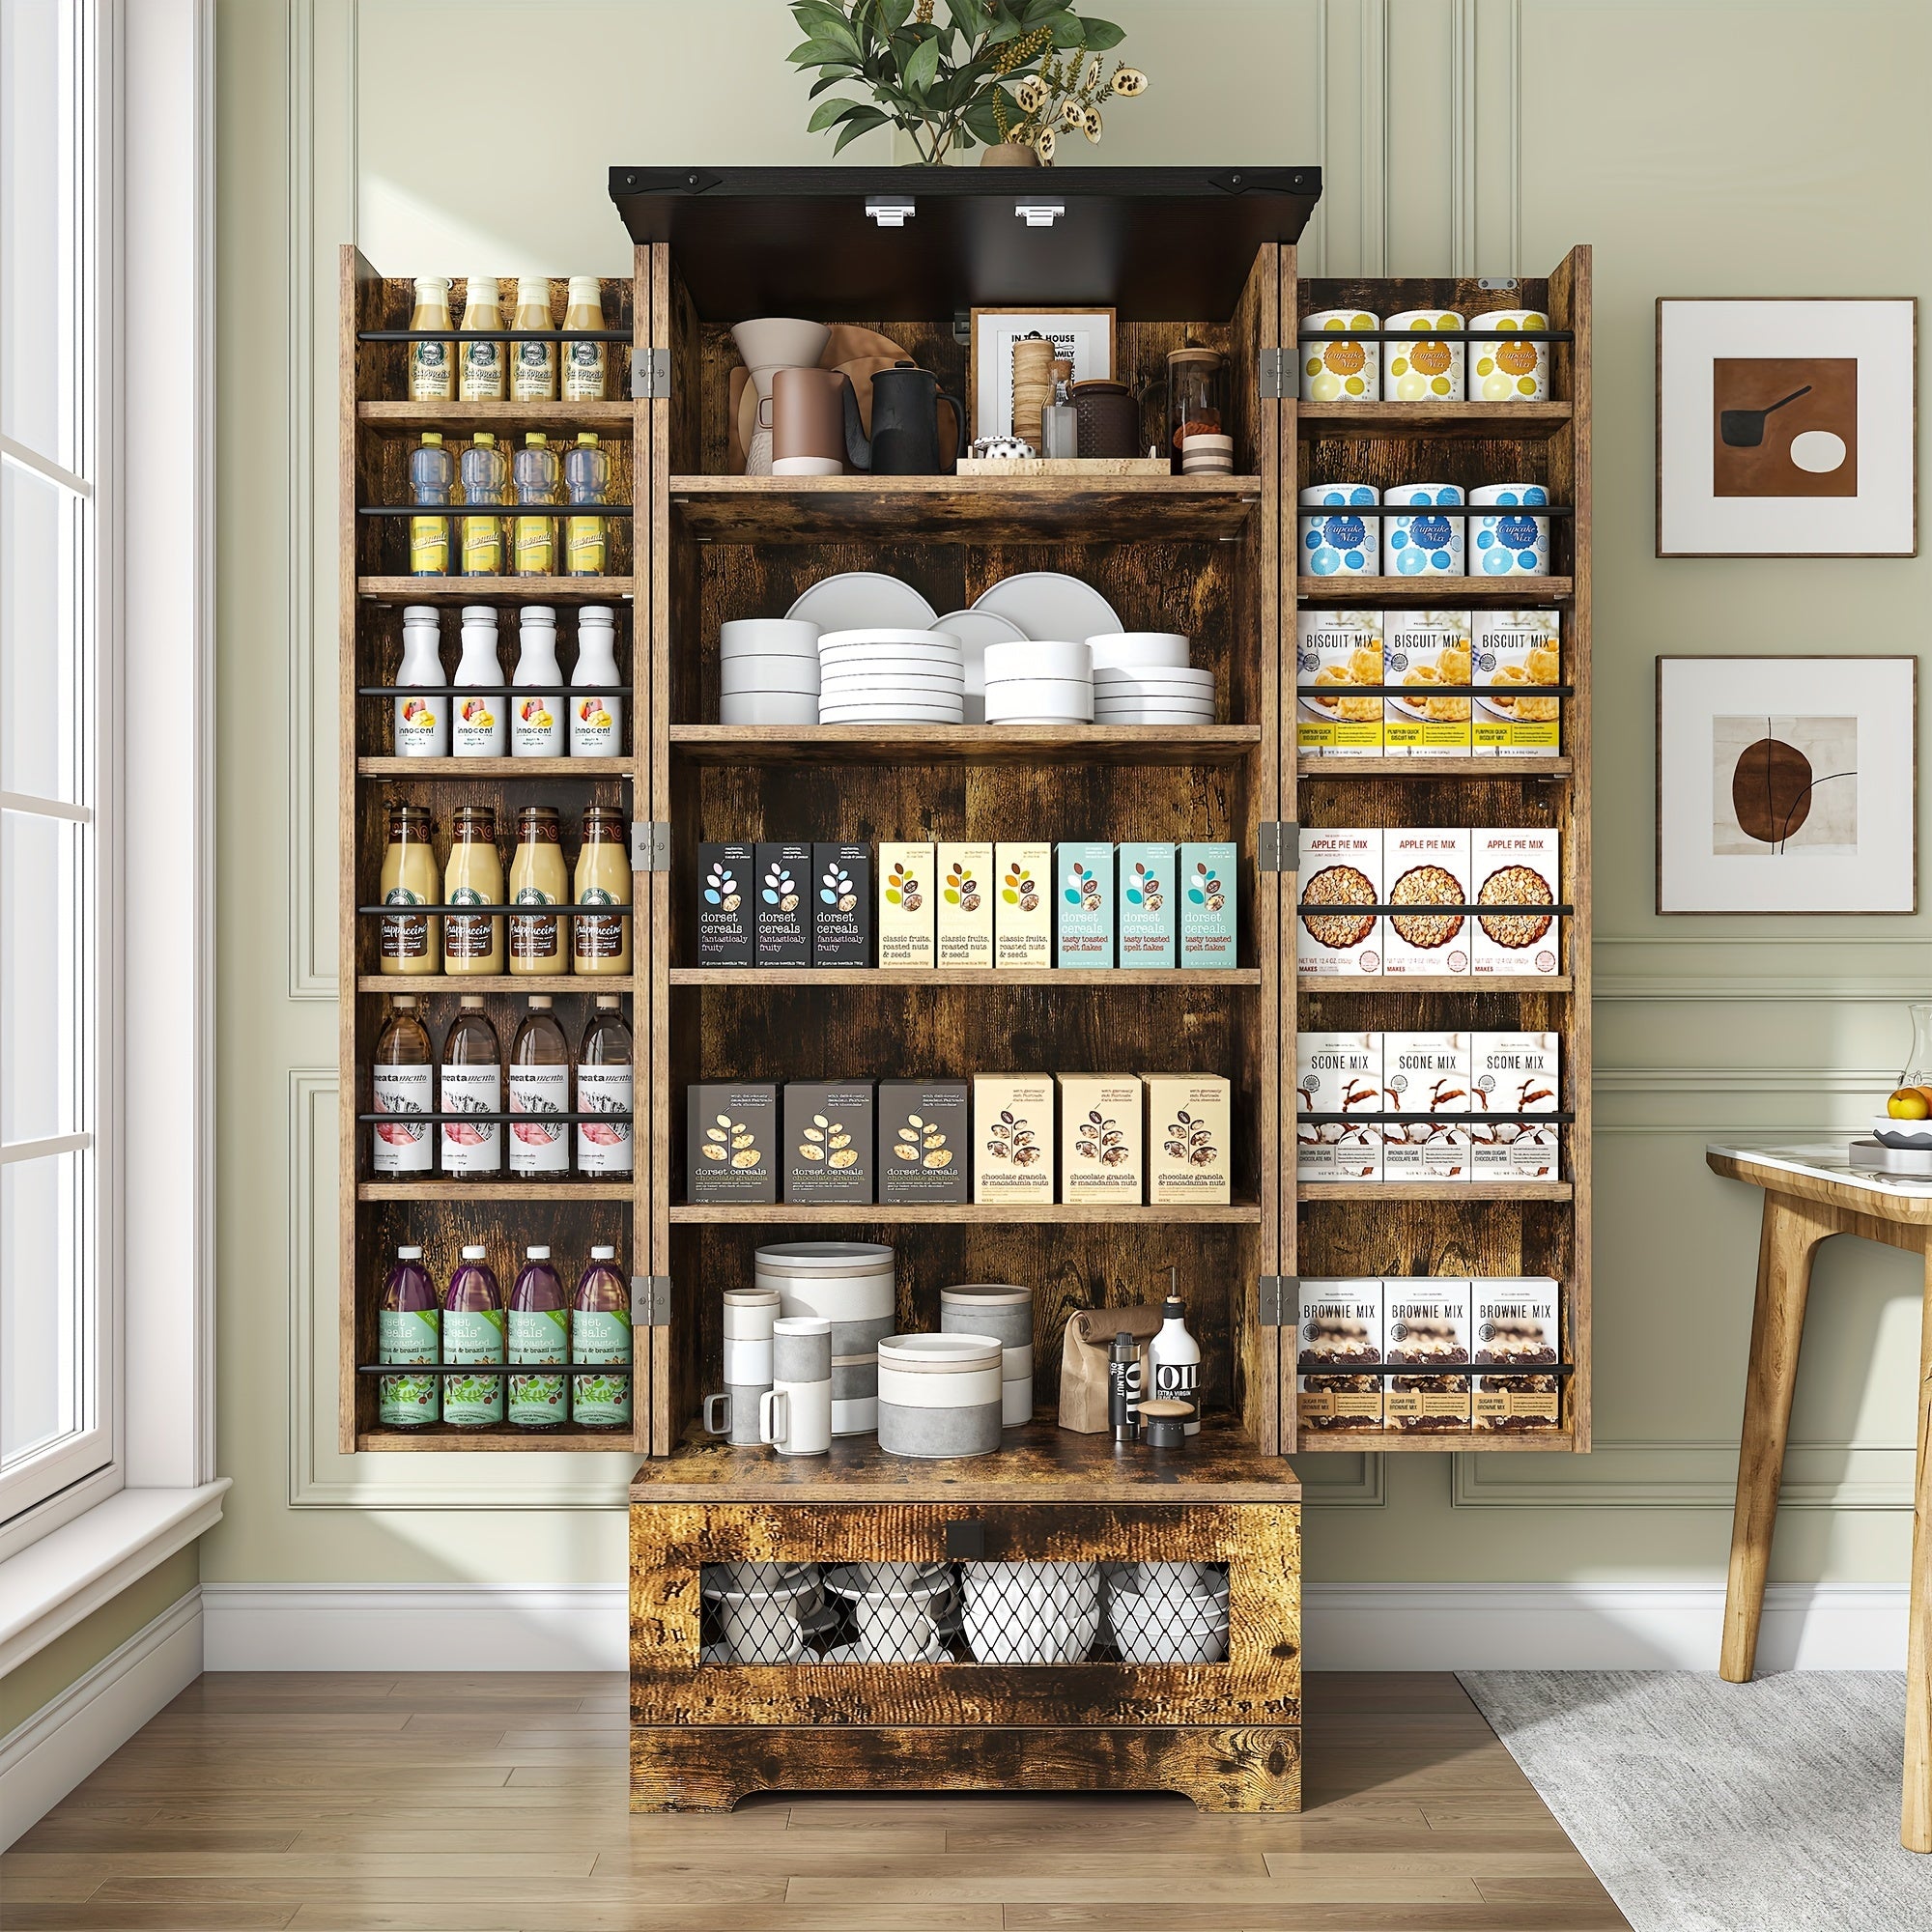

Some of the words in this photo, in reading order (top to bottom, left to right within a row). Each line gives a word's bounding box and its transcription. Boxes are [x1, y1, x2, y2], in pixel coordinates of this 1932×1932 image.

[1306, 635, 1349, 647] BISCUIT
[1355, 635, 1374, 647] MIX
[1394, 635, 1436, 647] BISCUIT
[1443, 635, 1462, 647] MIX
[1482, 635, 1524, 647] BISCUIT
[1531, 635, 1549, 647] MIX
[701, 912, 738, 923] dorset
[759, 912, 796, 923] dorset
[817, 912, 854, 923] dorset
[1062, 912, 1098, 923] dorset
[1123, 912, 1160, 923] dorset
[1185, 912, 1222, 923] dorset
[701, 923, 742, 933] cereals
[759, 923, 800, 933] cereals
[817, 923, 858, 933] cereals
[1062, 923, 1102, 934] cereals
[1123, 923, 1164, 934] cereals
[1185, 923, 1226, 934] cereals
[1311, 1056, 1345, 1069] SCONE
[1350, 1056, 1369, 1069] MIX
[1399, 1056, 1433, 1069] SCONE
[1437, 1056, 1457, 1069] MIX
[1487, 1056, 1520, 1069] SCONE
[1525, 1056, 1544, 1069] MIX
[1304, 1305, 1350, 1319] BROWNIE
[1356, 1305, 1376, 1319] MIX
[1392, 1305, 1439, 1319] BROWNIE
[1445, 1305, 1463, 1319] MIX
[1480, 1305, 1527, 1319] BROWNIE
[1533, 1305, 1551, 1319] MIX
[1157, 1365, 1201, 1390] OIL
